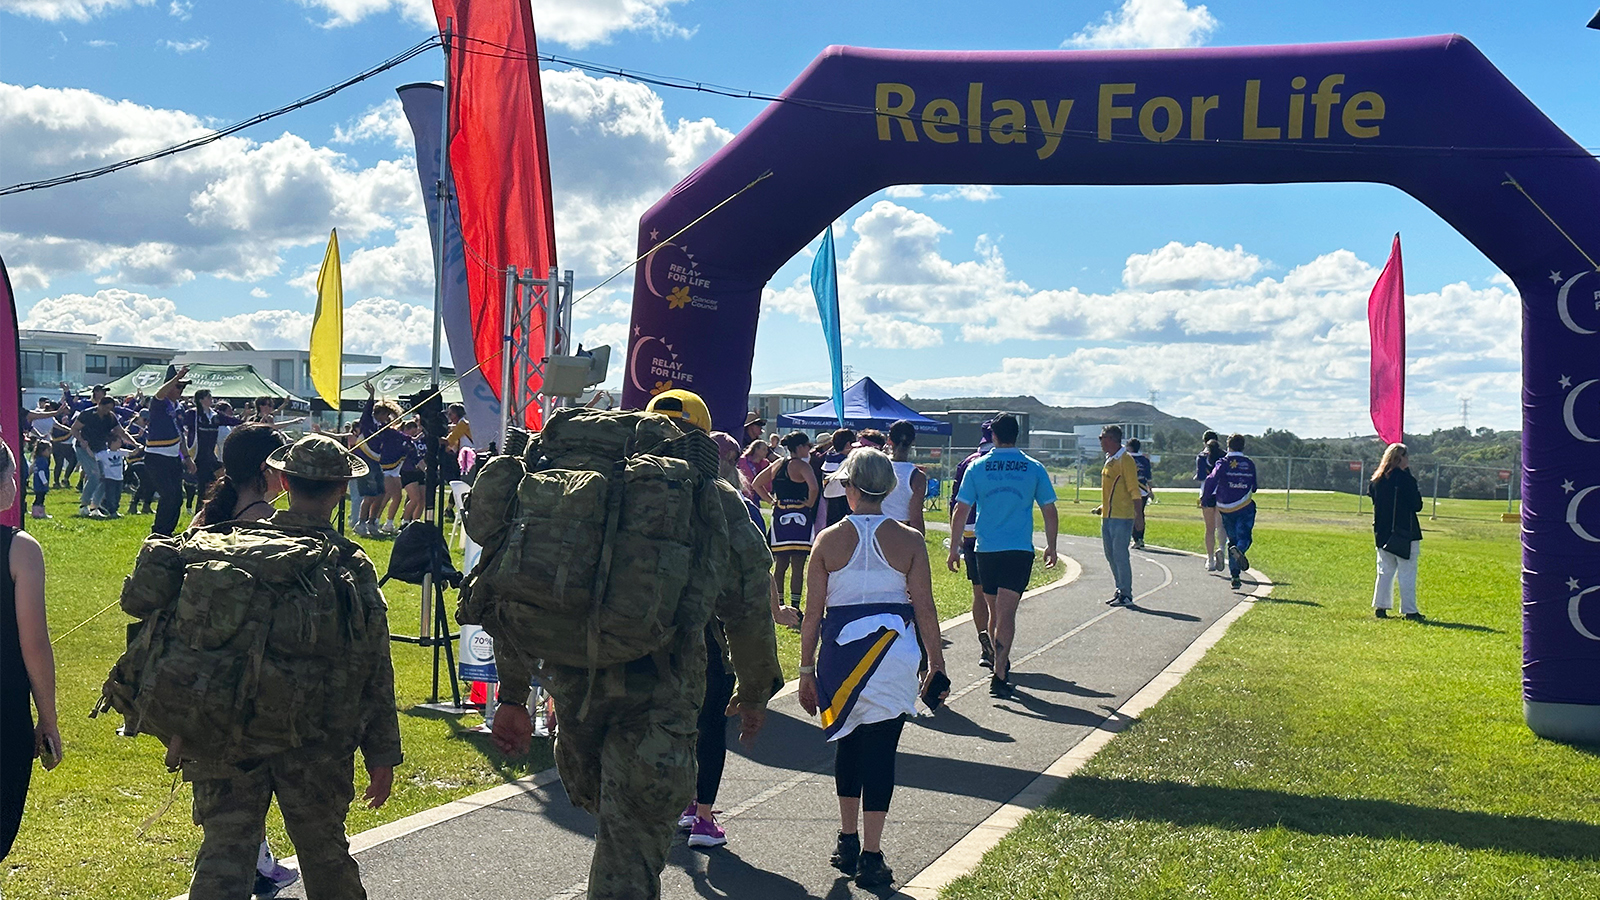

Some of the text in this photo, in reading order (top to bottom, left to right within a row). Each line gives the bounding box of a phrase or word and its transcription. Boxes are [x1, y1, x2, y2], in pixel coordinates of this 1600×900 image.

[875, 74, 1387, 160] Relay For Life
[669, 263, 702, 277] RELAY
[667, 271, 711, 289] FOR LIFE
[691, 300, 718, 310] Council
[692, 295, 718, 305] Cancer
[651, 357, 683, 371] RELAY
[211, 373, 245, 381] Bosco
[650, 366, 694, 383] FOR LIFE
[190, 378, 224, 386] ollege
[985, 460, 1029, 472] BLEW BOARS
[474, 636, 493, 646] 70%
